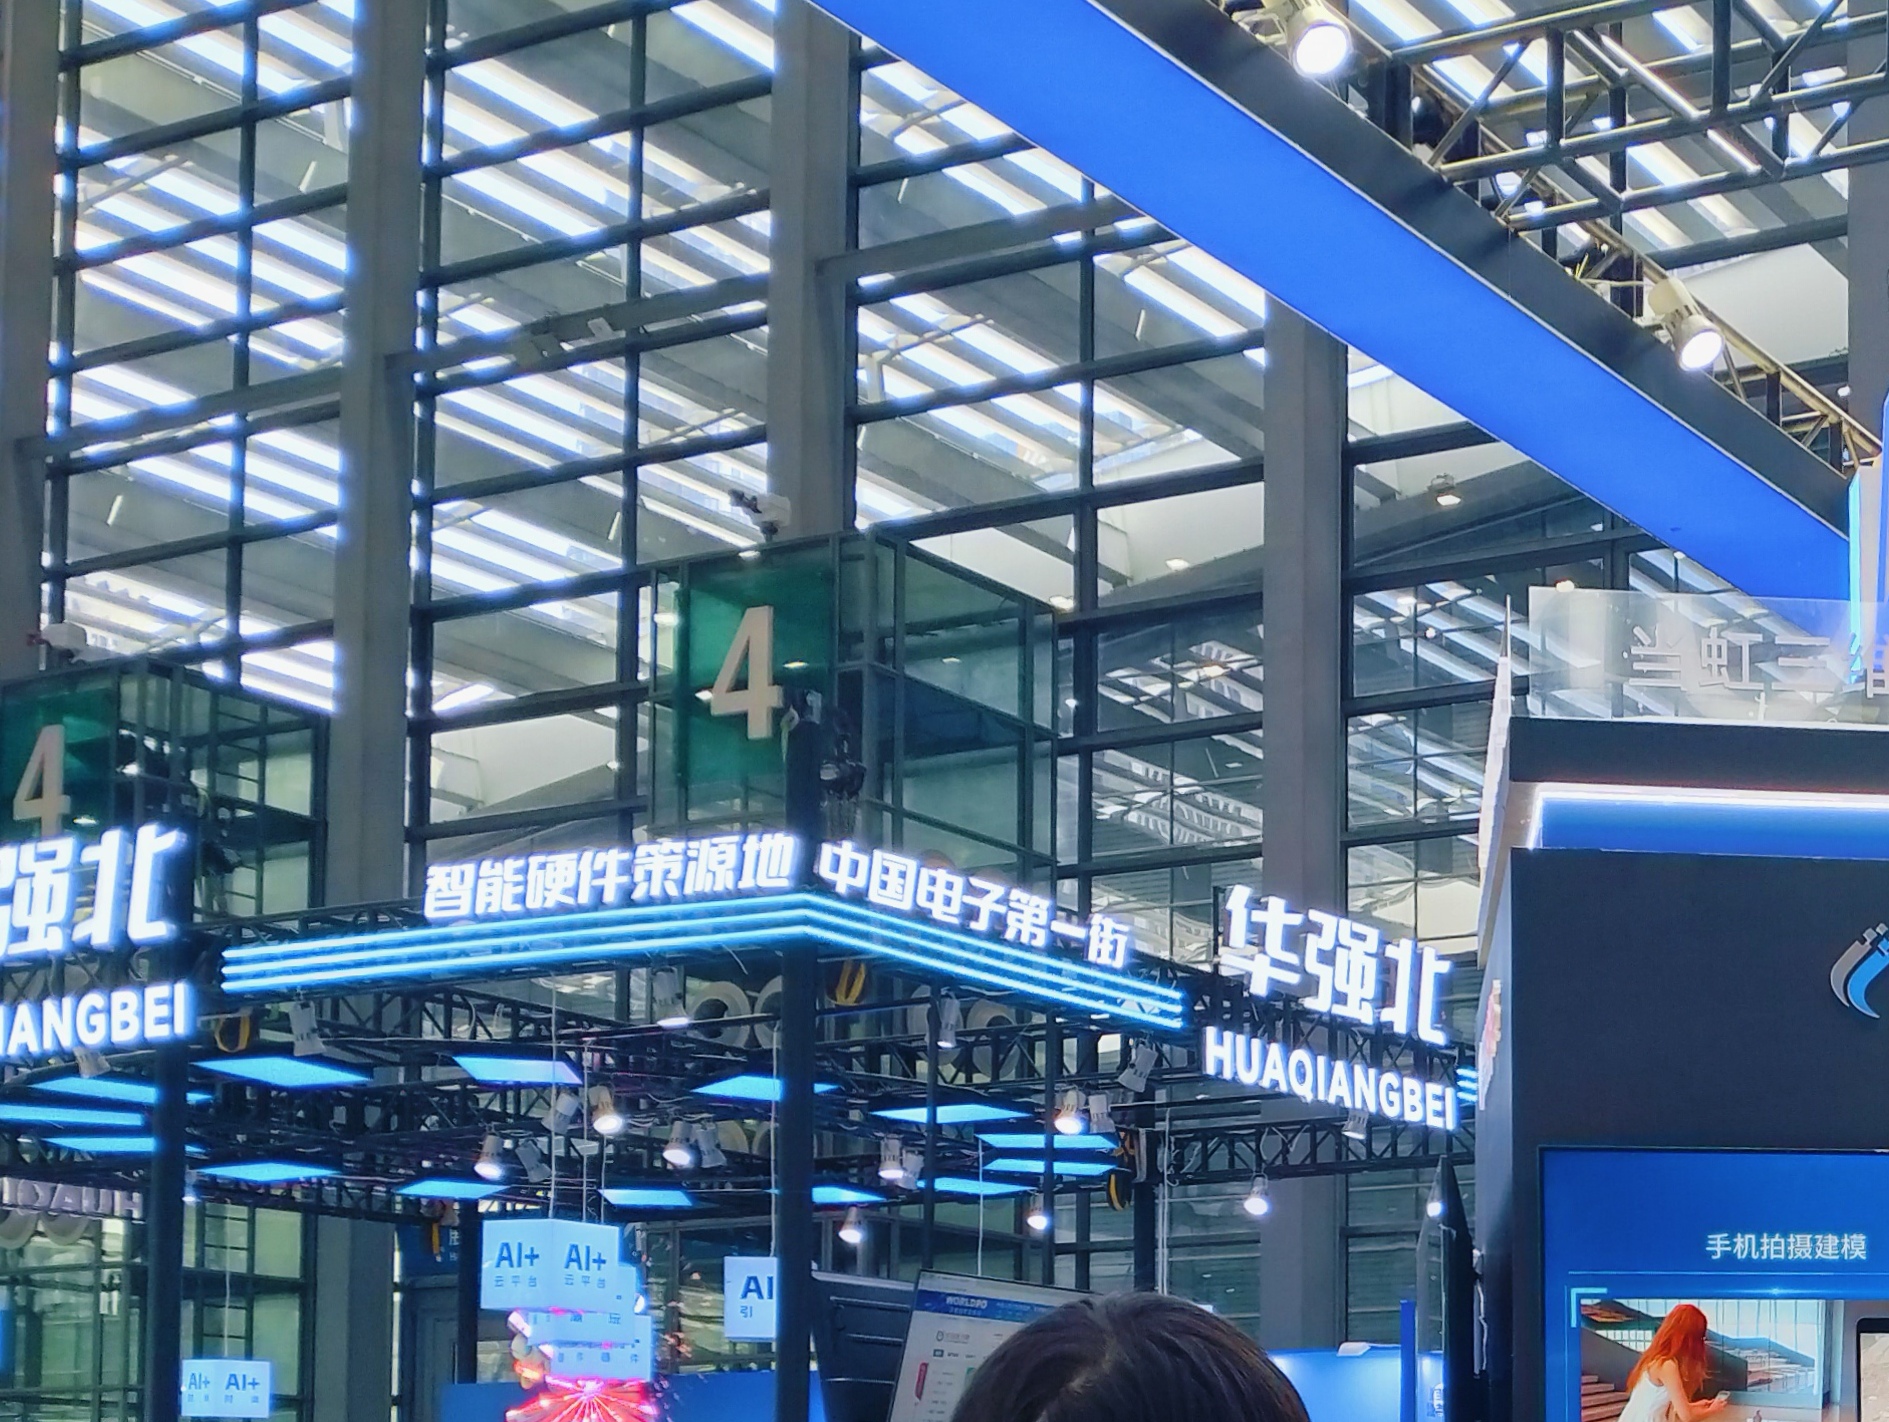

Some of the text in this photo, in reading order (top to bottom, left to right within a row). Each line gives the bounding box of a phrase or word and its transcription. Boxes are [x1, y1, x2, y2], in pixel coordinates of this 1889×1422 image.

[711, 605, 783, 739] 4
[13, 724, 71, 837] 4
[423, 832, 798, 920] 智能硬件策源地
[816, 840, 1130, 969] 中国电子第一街
[1219, 884, 1454, 1047] 华强北
[1204, 1026, 1460, 1131] HUAQIANGBEI
[495, 1242, 540, 1269] AI+
[563, 1244, 607, 1272] AI+
[1705, 1232, 1868, 1261] 手机拍摄建模
[225, 1374, 259, 1391] AI+
